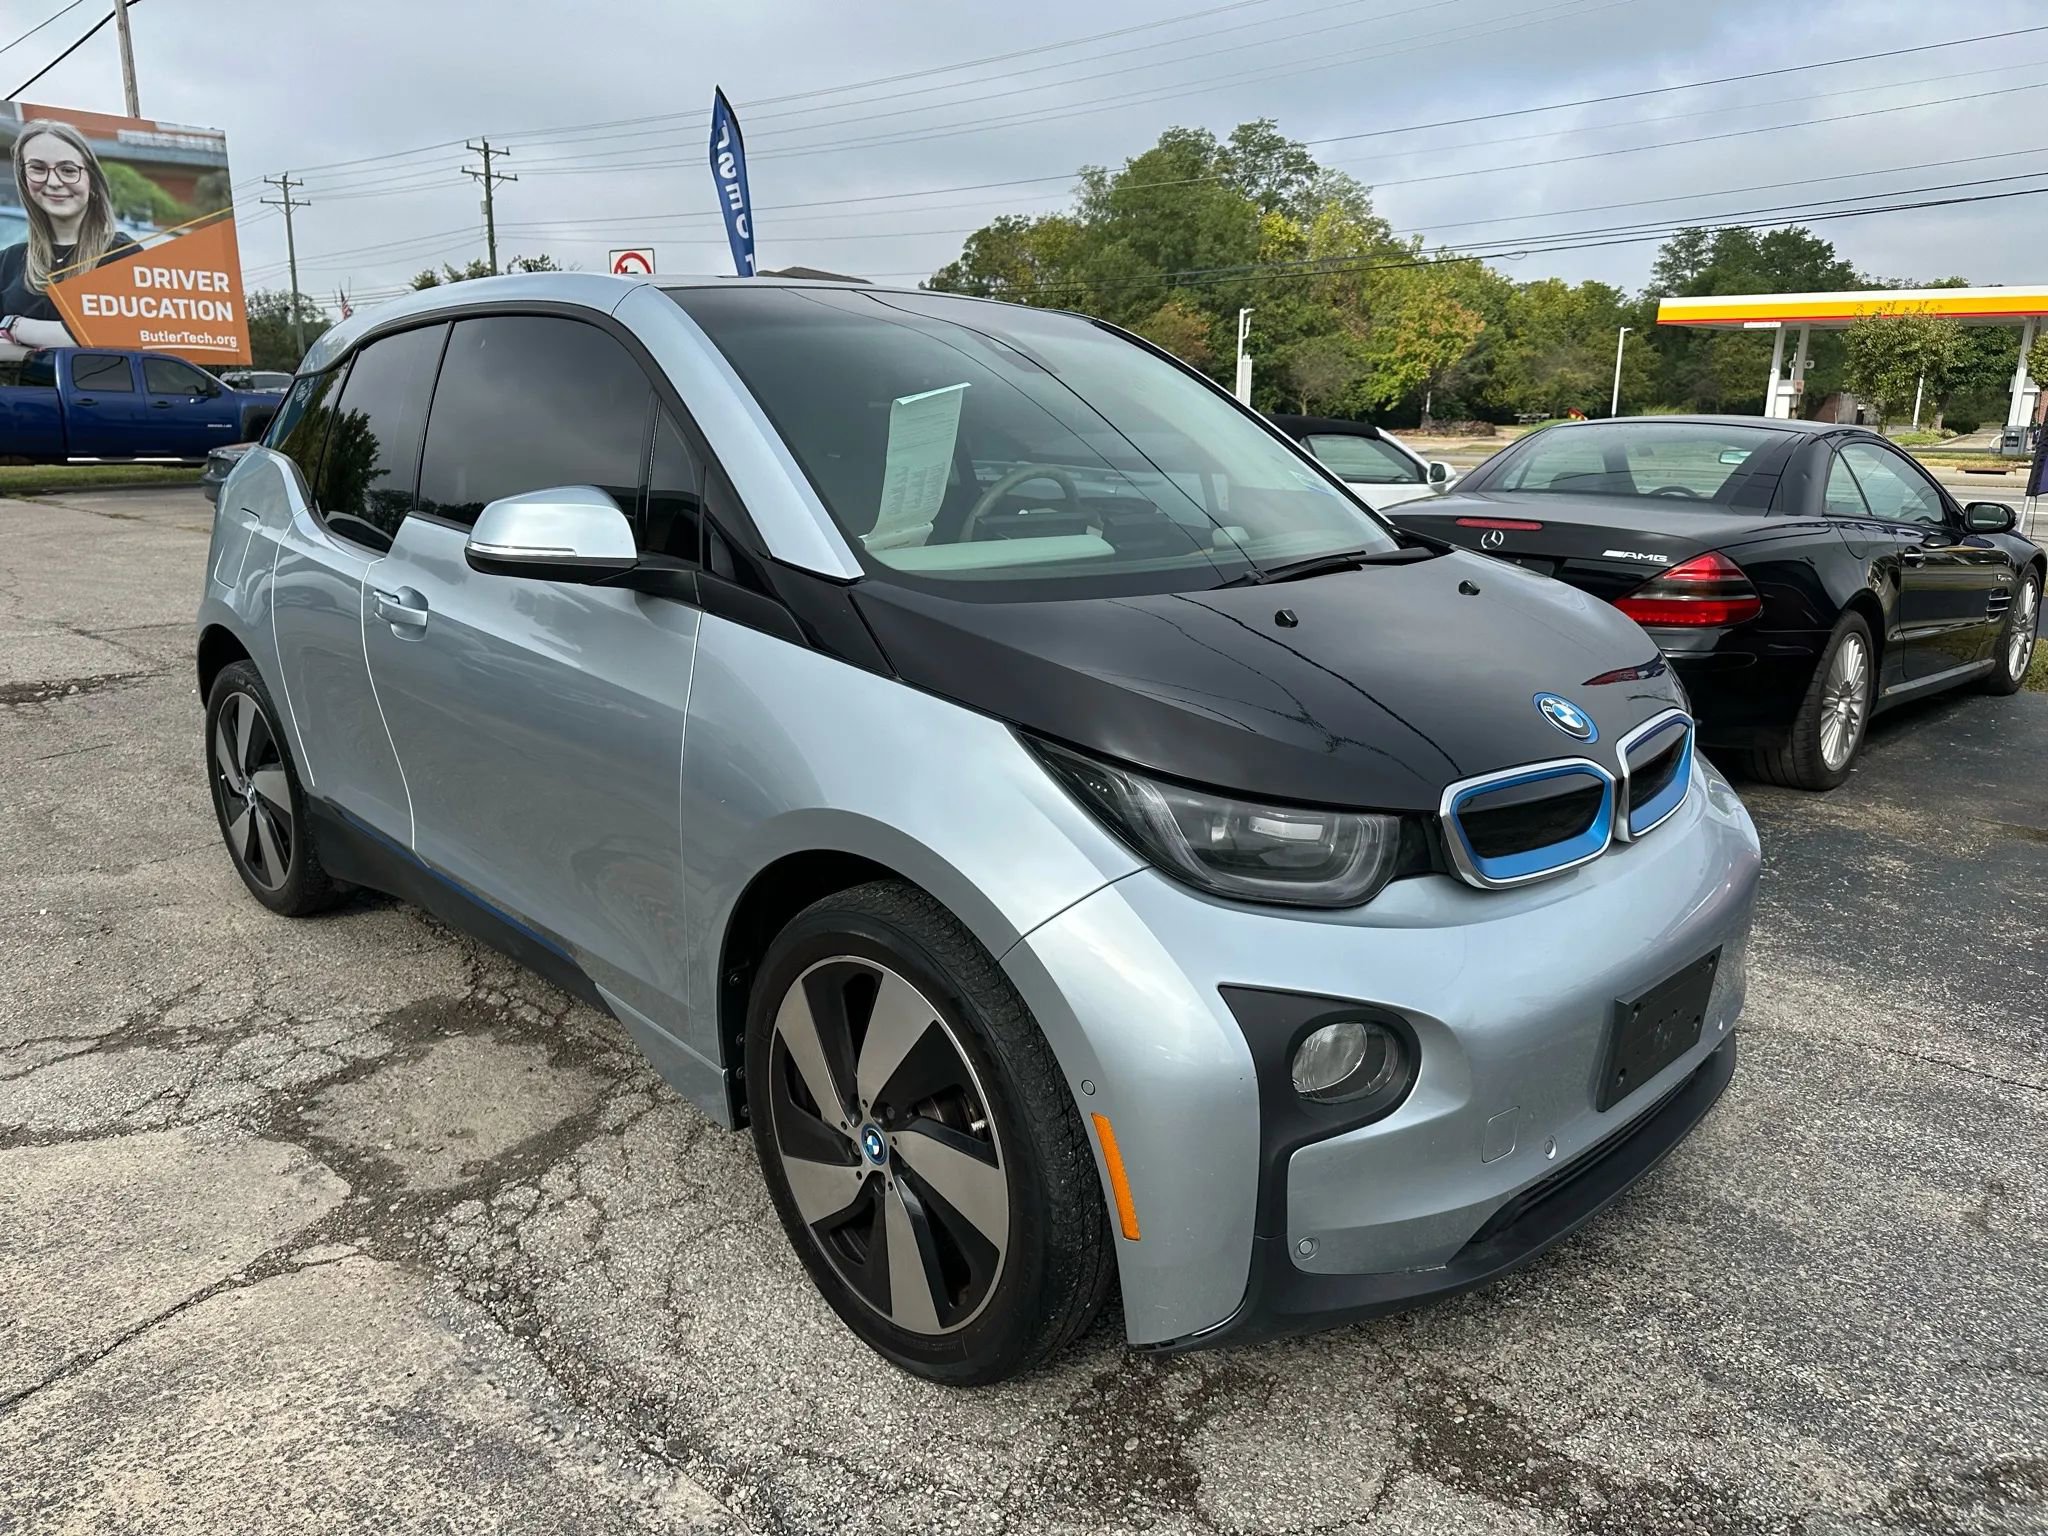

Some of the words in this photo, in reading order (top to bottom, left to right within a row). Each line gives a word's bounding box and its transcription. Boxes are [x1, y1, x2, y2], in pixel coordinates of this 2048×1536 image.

[133, 266, 230, 293] DRIVER
[81, 294, 234, 322] EDUCATION
[140, 330, 237, 347] ButlerTech.org
[1622, 551, 1668, 562] AMG
